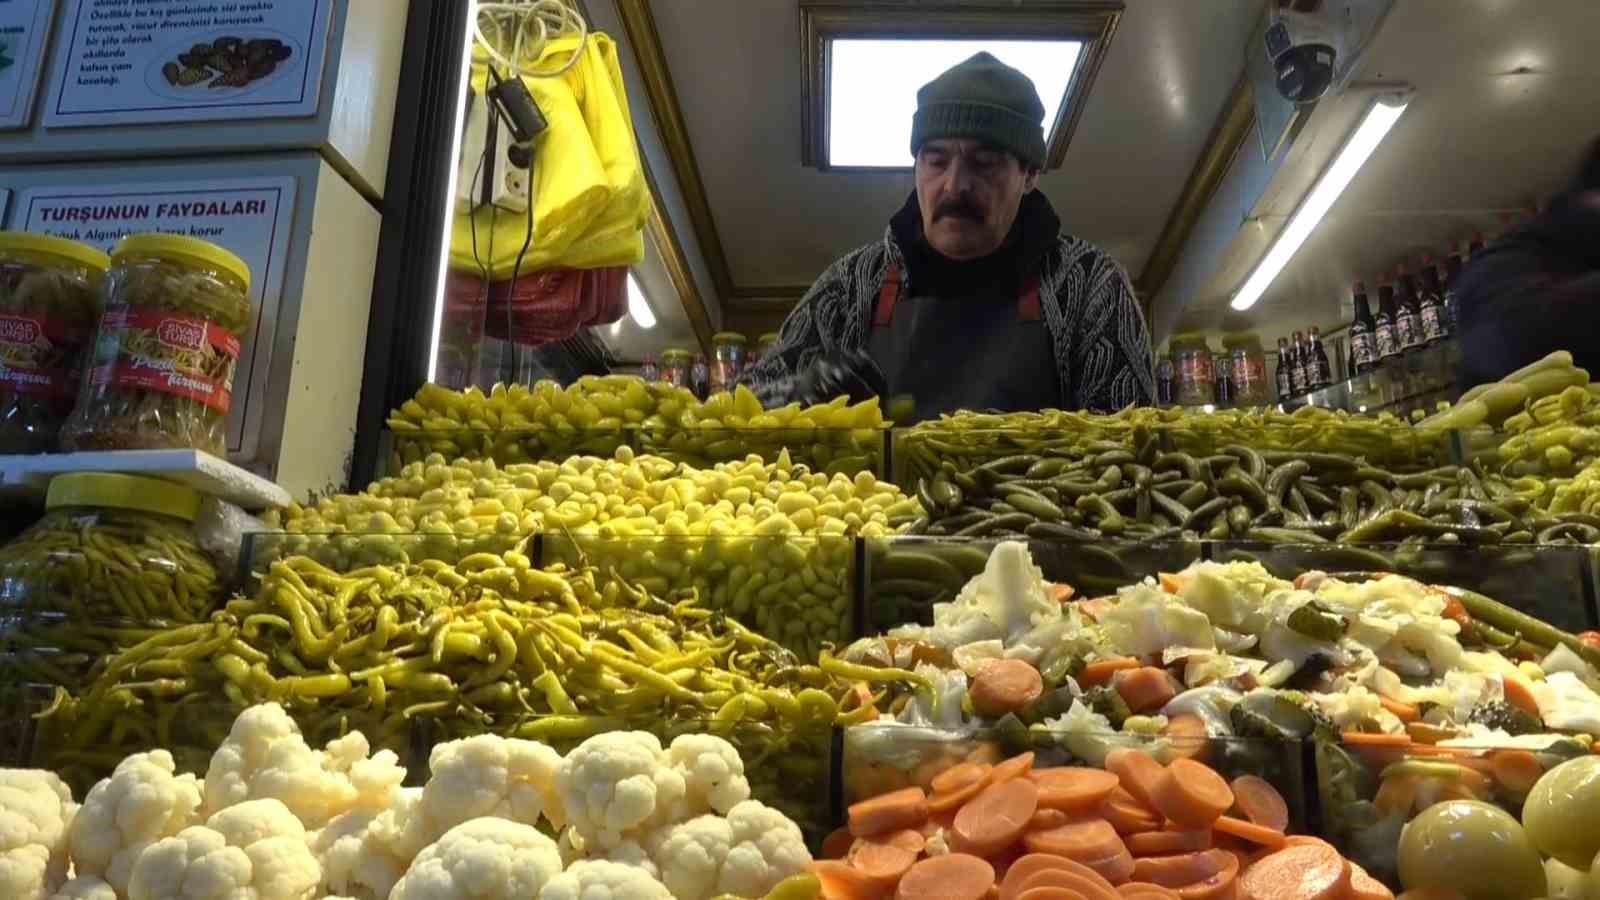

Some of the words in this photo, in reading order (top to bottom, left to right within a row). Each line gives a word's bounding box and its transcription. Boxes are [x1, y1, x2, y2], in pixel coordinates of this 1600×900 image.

[40, 203, 150, 224] TURŞUNUN
[156, 199, 267, 219] FAYDALARI
[190, 224, 224, 237] korur
